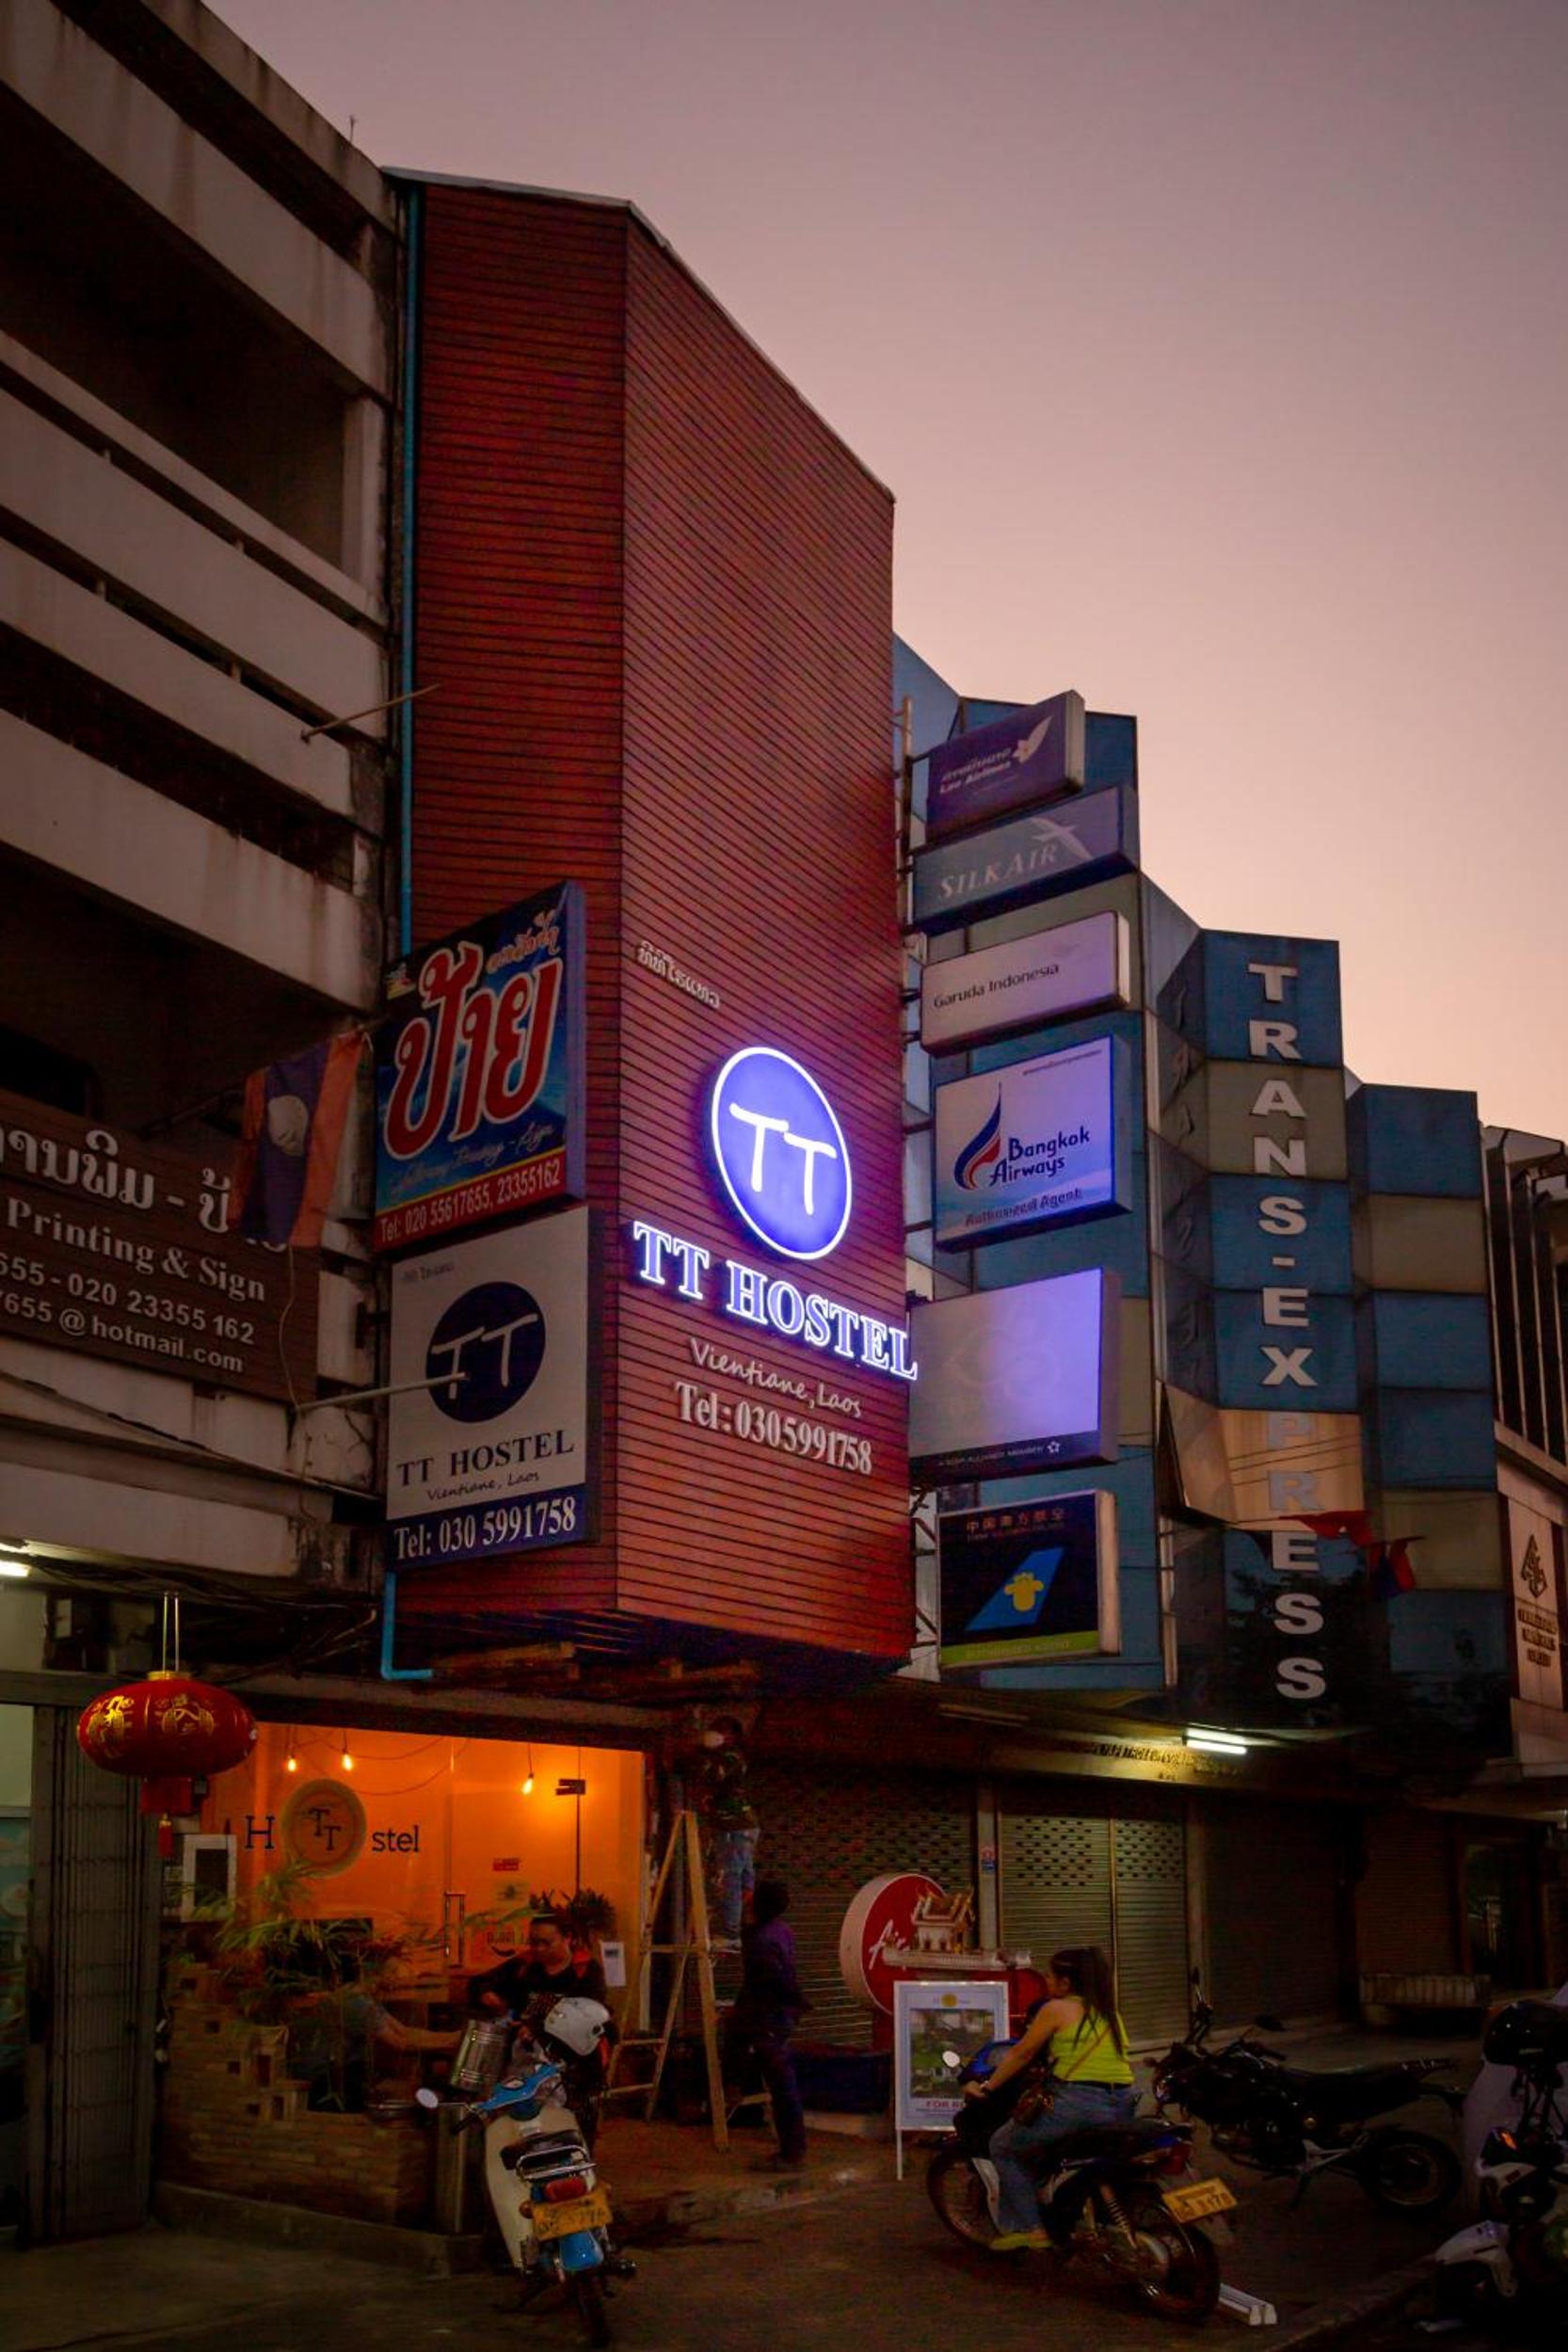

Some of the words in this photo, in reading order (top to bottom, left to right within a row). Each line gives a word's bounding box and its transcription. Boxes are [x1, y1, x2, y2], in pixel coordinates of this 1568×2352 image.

[939, 844, 1058, 898] SILKAIR
[934, 984, 984, 1008] Garuda
[988, 962, 1059, 992] Indonesia
[0, 1130, 154, 1209] ານພິມ
[729, 1102, 837, 1215] TT
[1008, 1125, 1090, 1161] Bangkok
[989, 1157, 1065, 1187] Airways
[1041, 1188, 1081, 1210] Agent
[380, 1220, 403, 1243] Tel:
[405, 1205, 426, 1238] 020
[496, 1159, 561, 1204] 23355162
[7, 1197, 153, 1274] Printing
[162, 1247, 188, 1278] &
[199, 1256, 264, 1302] Sign
[633, 1221, 710, 1300] TT
[726, 1260, 918, 1380] HOSTEL
[396, 1458, 434, 1487] TT
[450, 1430, 575, 1478] HOSTEL
[507, 1471, 539, 1488] Laos
[394, 1526, 432, 1560] Tel:
[439, 1516, 476, 1552] 030
[483, 1496, 576, 1545] 5991758
